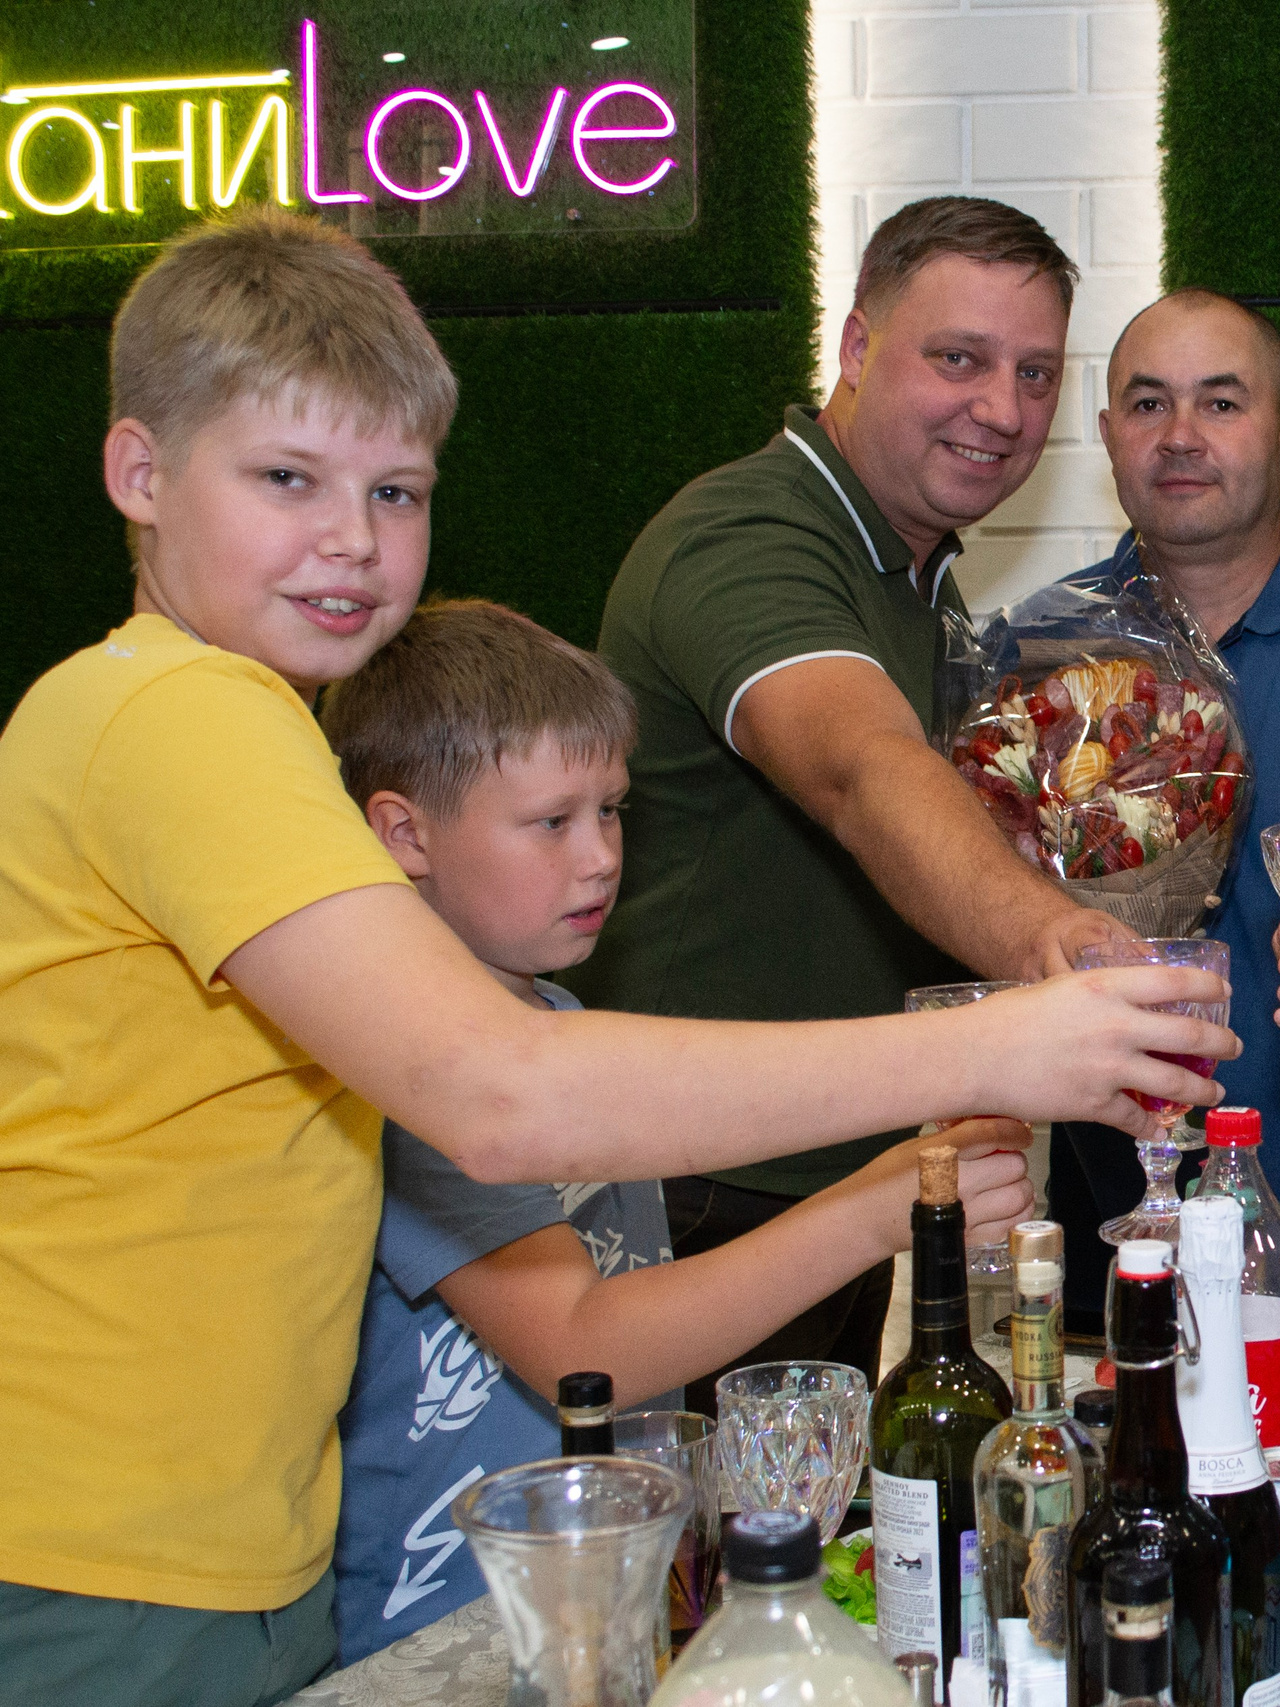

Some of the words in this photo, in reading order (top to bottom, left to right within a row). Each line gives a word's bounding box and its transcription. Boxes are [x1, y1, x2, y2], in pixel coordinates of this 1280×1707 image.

[0, 94, 294, 217] ани
[1198, 1457, 1244, 1472] BOSCA
[902, 1490, 929, 1500] BLEND
